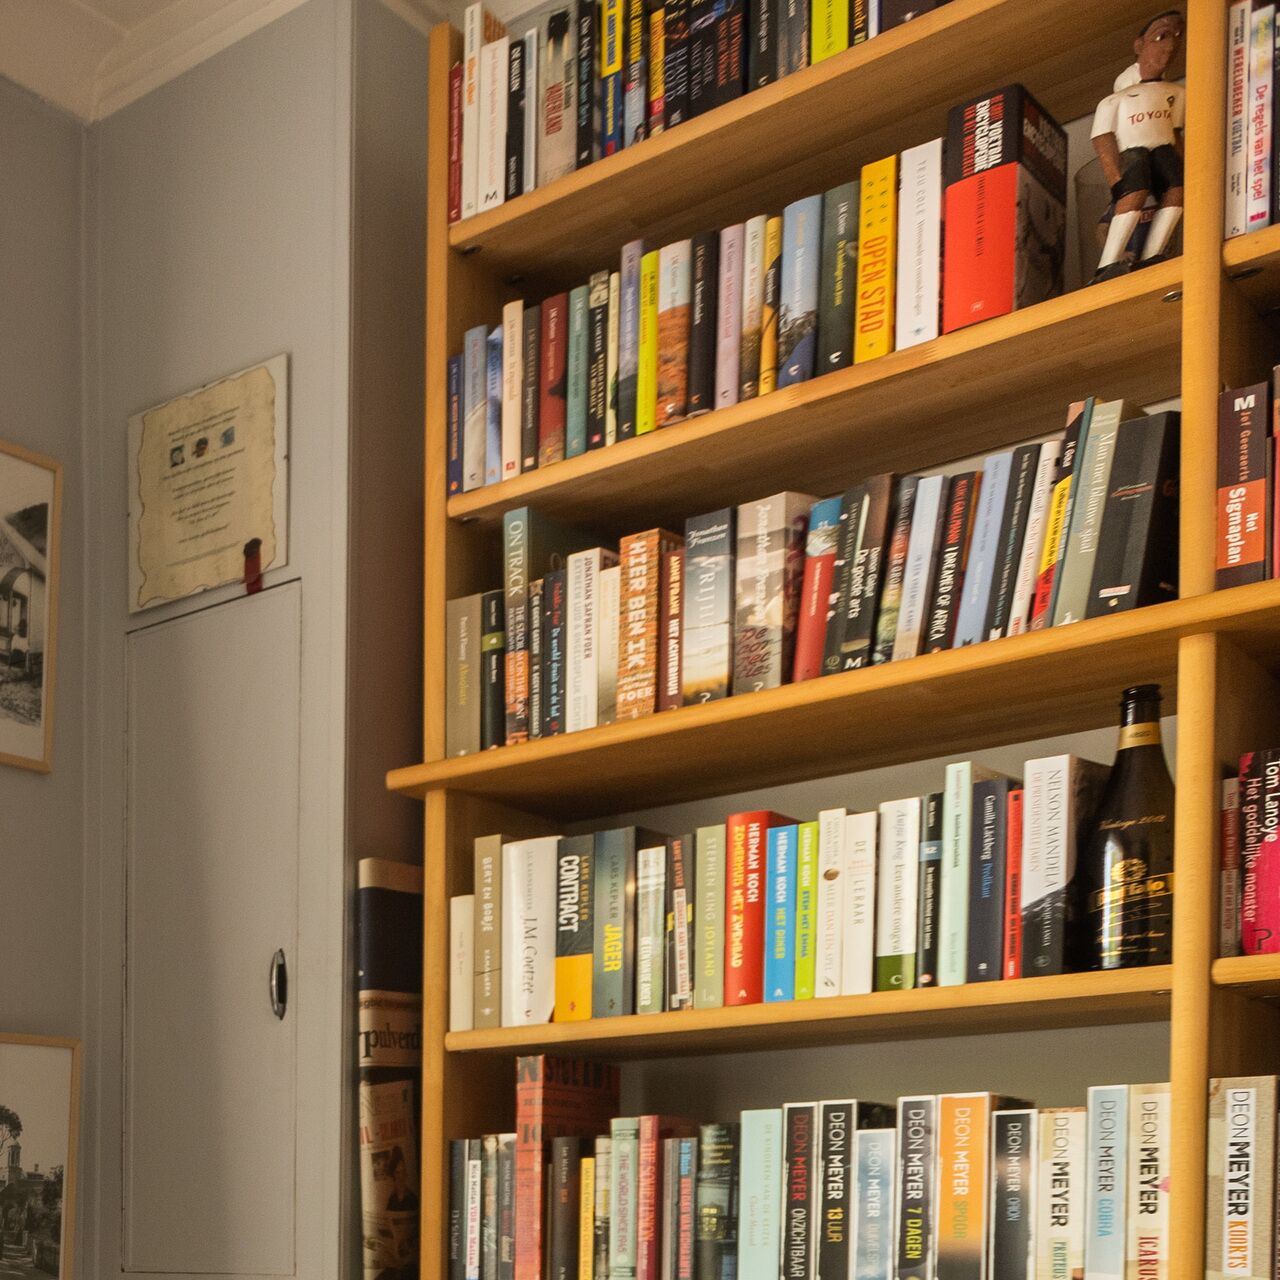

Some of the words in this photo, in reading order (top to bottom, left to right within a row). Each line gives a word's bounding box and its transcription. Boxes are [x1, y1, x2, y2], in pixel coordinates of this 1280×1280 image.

[675, 45, 688, 98] BLAUW
[690, 39, 702, 72] VALSE
[702, 42, 713, 86] ONDER
[663, 51, 676, 104] BLOED
[690, 70, 702, 101] VLAG
[544, 80, 563, 138] VADERLAND
[973, 97, 991, 174] ENCYCLOPEDIE
[988, 120, 1003, 168] VOETBAL
[860, 232, 888, 287] OPEN
[860, 284, 886, 335] STAD
[951, 478, 967, 500] KUKI
[507, 518, 523, 546] ON
[945, 500, 965, 545] GALLMANN
[1225, 486, 1247, 564] Sigmaplan
[1245, 512, 1259, 532] Het
[507, 548, 523, 598] TRACK
[627, 539, 646, 593] HIER
[669, 553, 680, 583] ANNE
[856, 548, 868, 564] De
[938, 552, 958, 592] DREAMED
[583, 555, 593, 601] JONATHAN
[849, 565, 865, 596] goede
[582, 601, 592, 636] SAFRAN
[627, 594, 646, 638] BEN
[669, 581, 679, 616] FRANK
[847, 597, 861, 619] arts
[935, 594, 952, 607] OF
[668, 617, 679, 639] HET
[930, 607, 949, 640] AFRICA
[582, 636, 591, 659] FOER
[627, 637, 646, 670] IK
[667, 637, 678, 696] ACHTERHUIS
[1247, 778, 1262, 799] Het
[732, 823, 744, 887] ZOMERHUIS
[746, 821, 760, 870] HERMAN
[775, 831, 787, 873] HERMAN
[854, 840, 865, 856] DE
[1243, 804, 1261, 869] goddelijke
[482, 855, 493, 883] BERT
[609, 854, 619, 879] LARS
[705, 836, 716, 887] STEPHEN
[482, 886, 492, 899] EN
[557, 854, 579, 934] CONTRACT
[608, 879, 618, 919] KEPLER
[705, 890, 716, 922] KING
[732, 888, 743, 912] MET
[746, 872, 759, 903] KOCH
[775, 875, 787, 904] KOCH
[852, 879, 864, 925] LERAAR
[1244, 872, 1258, 922] monster
[481, 901, 493, 932] BOBJE
[775, 906, 786, 927] HET
[602, 921, 622, 973] JAGER
[703, 924, 715, 977] JOYLAND
[730, 912, 743, 968] ZWEMBAD
[774, 928, 785, 960] DINER
[791, 1113, 806, 1153] DEON
[827, 1111, 846, 1152] DEON
[906, 1108, 926, 1149] DEON
[953, 1106, 971, 1146] DEON
[1098, 1100, 1117, 1140] DEON
[1140, 1100, 1157, 1144] DEON
[1231, 1090, 1251, 1138] DEON
[641, 1141, 655, 1164] THE
[1007, 1122, 1023, 1153] DEON
[1052, 1116, 1070, 1158] DEON
[618, 1152, 629, 1172] THE
[790, 1156, 806, 1200] MEYER
[827, 1154, 845, 1200] MEYER
[906, 1152, 924, 1200] MEYER
[952, 1149, 969, 1196] MEYER
[1006, 1156, 1021, 1192] MEYER
[1096, 1144, 1115, 1192] MEYER
[1137, 1146, 1160, 1215] MEYER
[1227, 1141, 1251, 1216] MEYER
[618, 1173, 628, 1206] WORLD
[641, 1166, 655, 1200] SOVIET
[1050, 1160, 1070, 1228] MEYER
[617, 1207, 628, 1233] SINCE
[641, 1205, 654, 1241] UNION
[826, 1206, 843, 1219] 13
[906, 1206, 922, 1214] 7
[953, 1200, 968, 1238] SPOOR
[1006, 1196, 1020, 1221] ORION
[1096, 1197, 1115, 1238] COBRA
[616, 1233, 627, 1253] 1945
[790, 1207, 805, 1278] ONZICHTBAAR
[825, 1220, 842, 1243] UUR
[904, 1217, 922, 1259] DAGEN
[1226, 1220, 1249, 1269] KOORTS
[1052, 1240, 1067, 1280] PROTEUS
